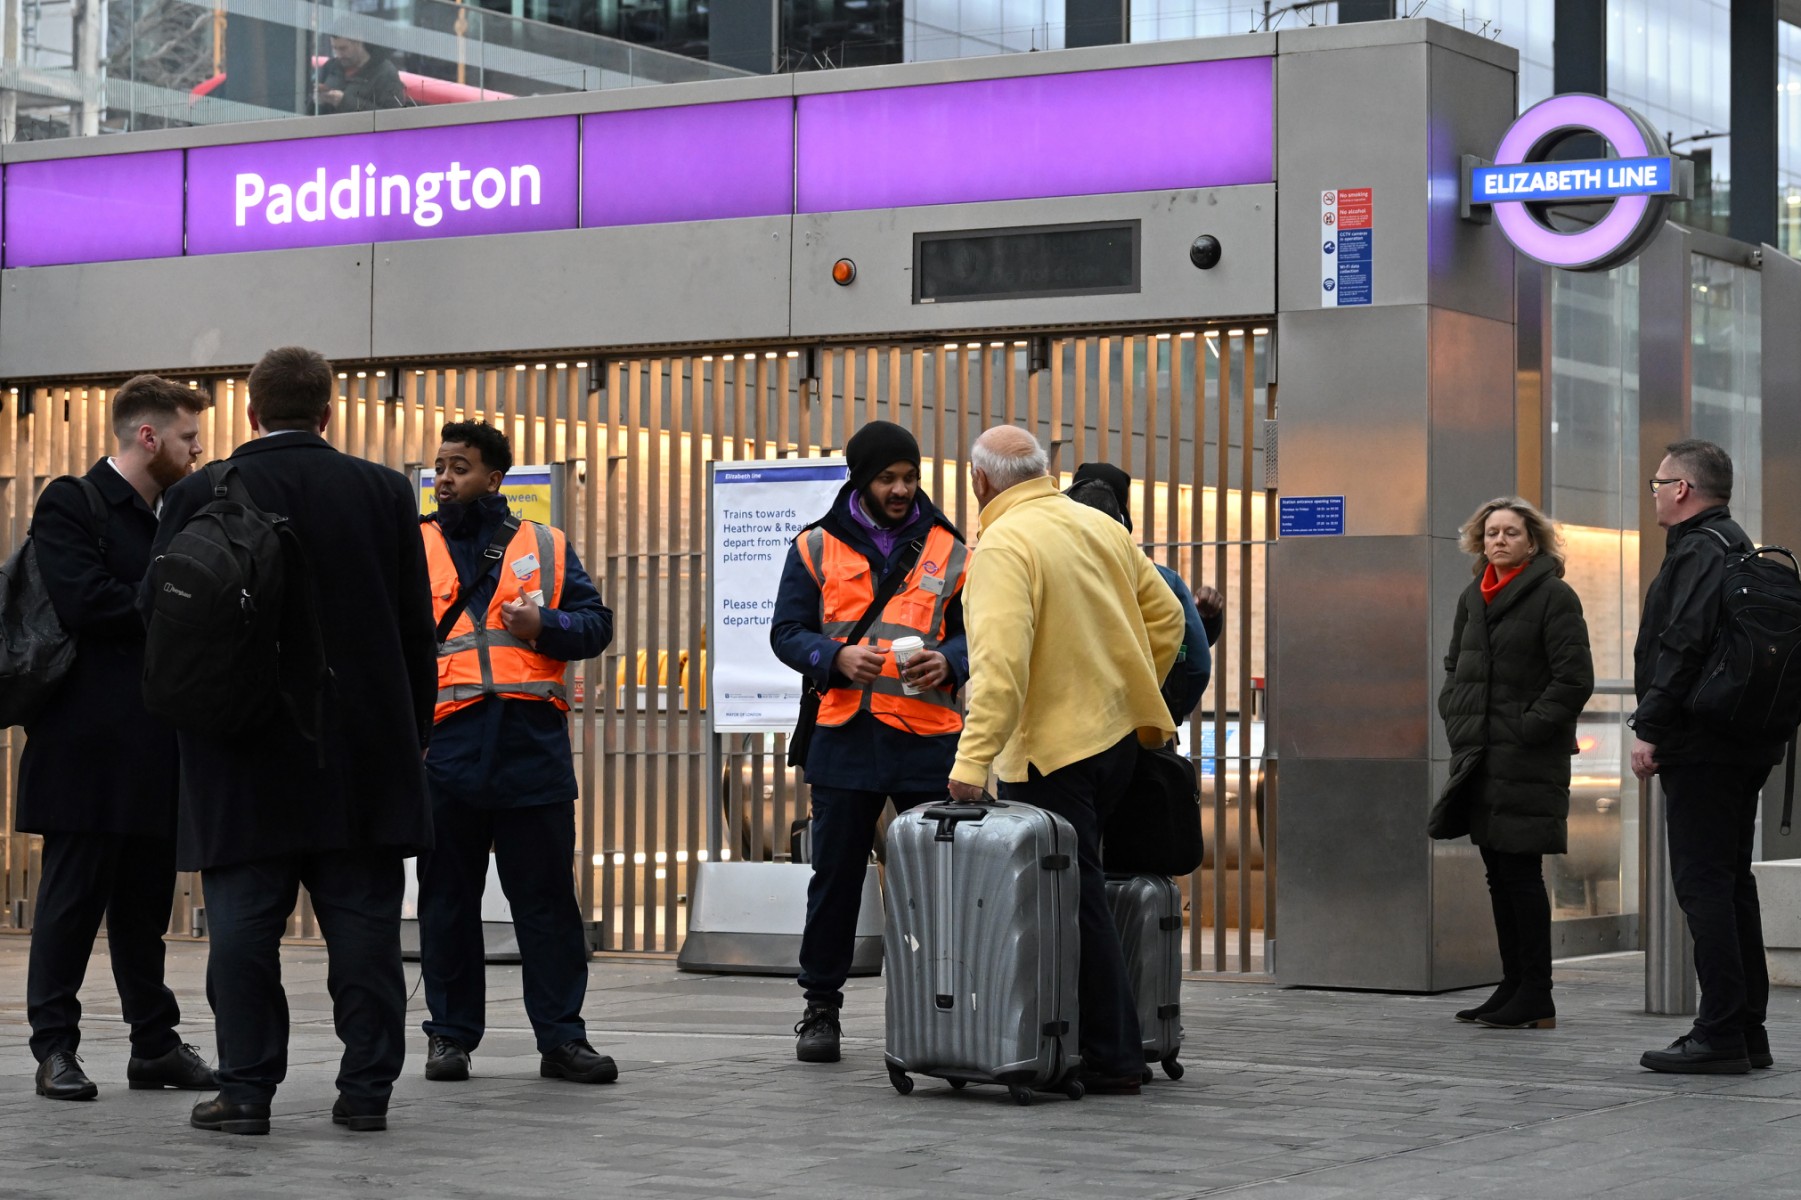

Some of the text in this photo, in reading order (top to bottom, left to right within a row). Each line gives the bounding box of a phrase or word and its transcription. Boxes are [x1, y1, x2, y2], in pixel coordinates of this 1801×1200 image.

[1485, 165, 1658, 195] ELIZABETH LINE
[235, 162, 541, 227] Paddington
[723, 508, 796, 519] Trains towards
[723, 523, 772, 533] Heathrow
[775, 523, 782, 532] &
[723, 538, 755, 549] depart
[757, 537, 781, 547] from
[723, 552, 772, 563] platforms
[723, 598, 775, 609] Please ch
[723, 615, 773, 627] departur
